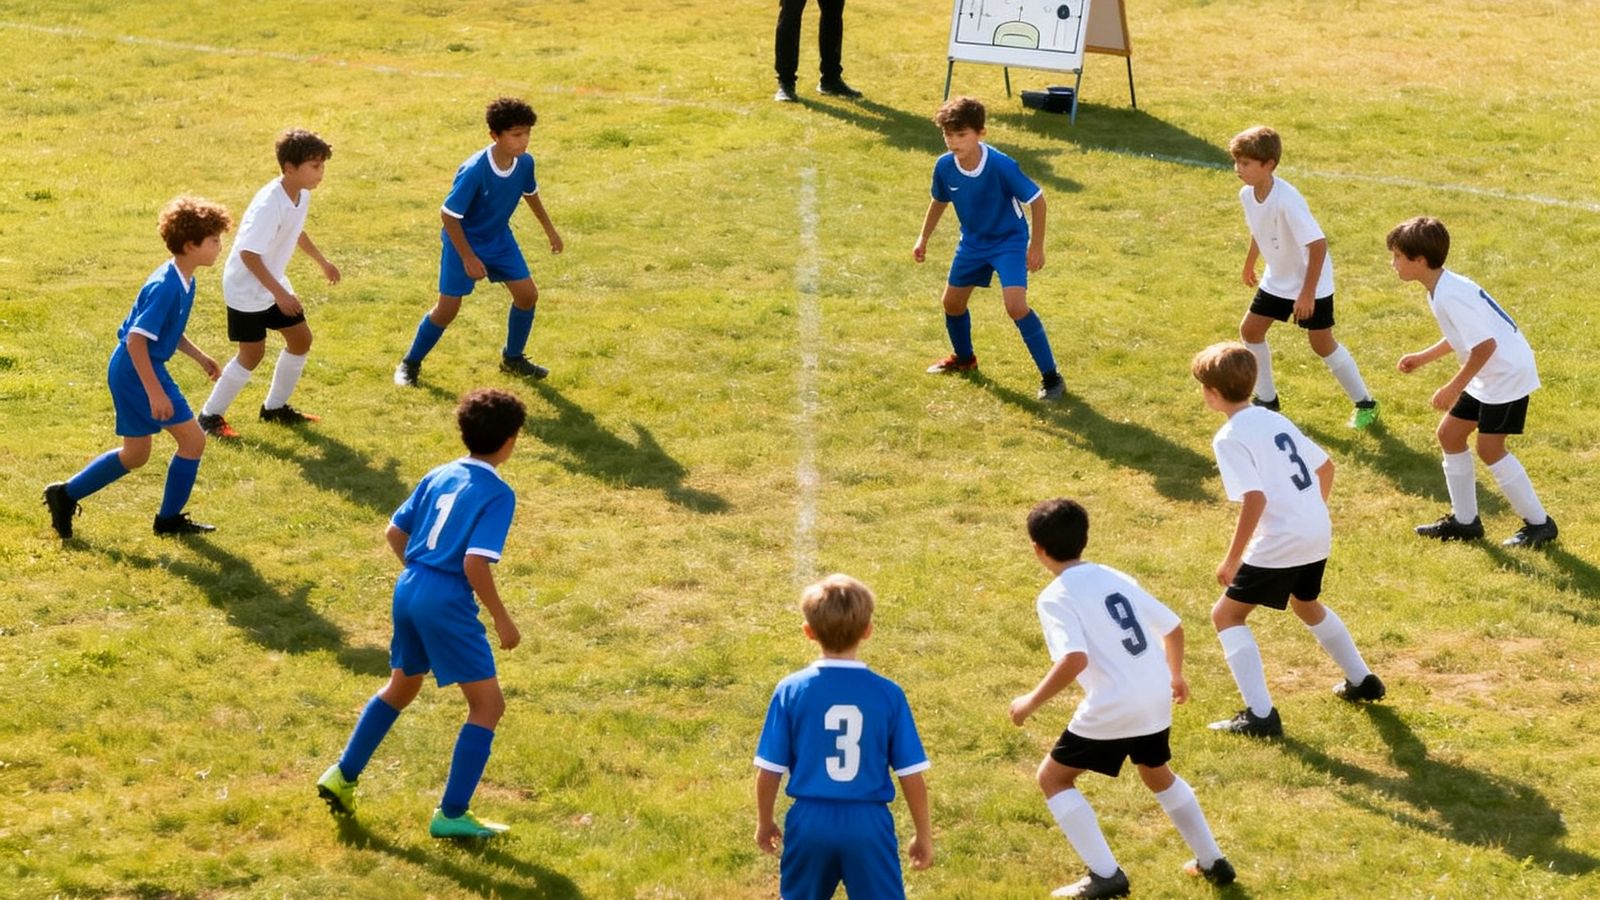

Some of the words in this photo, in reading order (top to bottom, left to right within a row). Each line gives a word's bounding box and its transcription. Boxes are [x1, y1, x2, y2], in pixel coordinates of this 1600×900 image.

[1274, 432, 1312, 491] 3
[426, 493, 457, 550] 1
[1105, 592, 1147, 656] 9
[824, 704, 863, 782] 3
